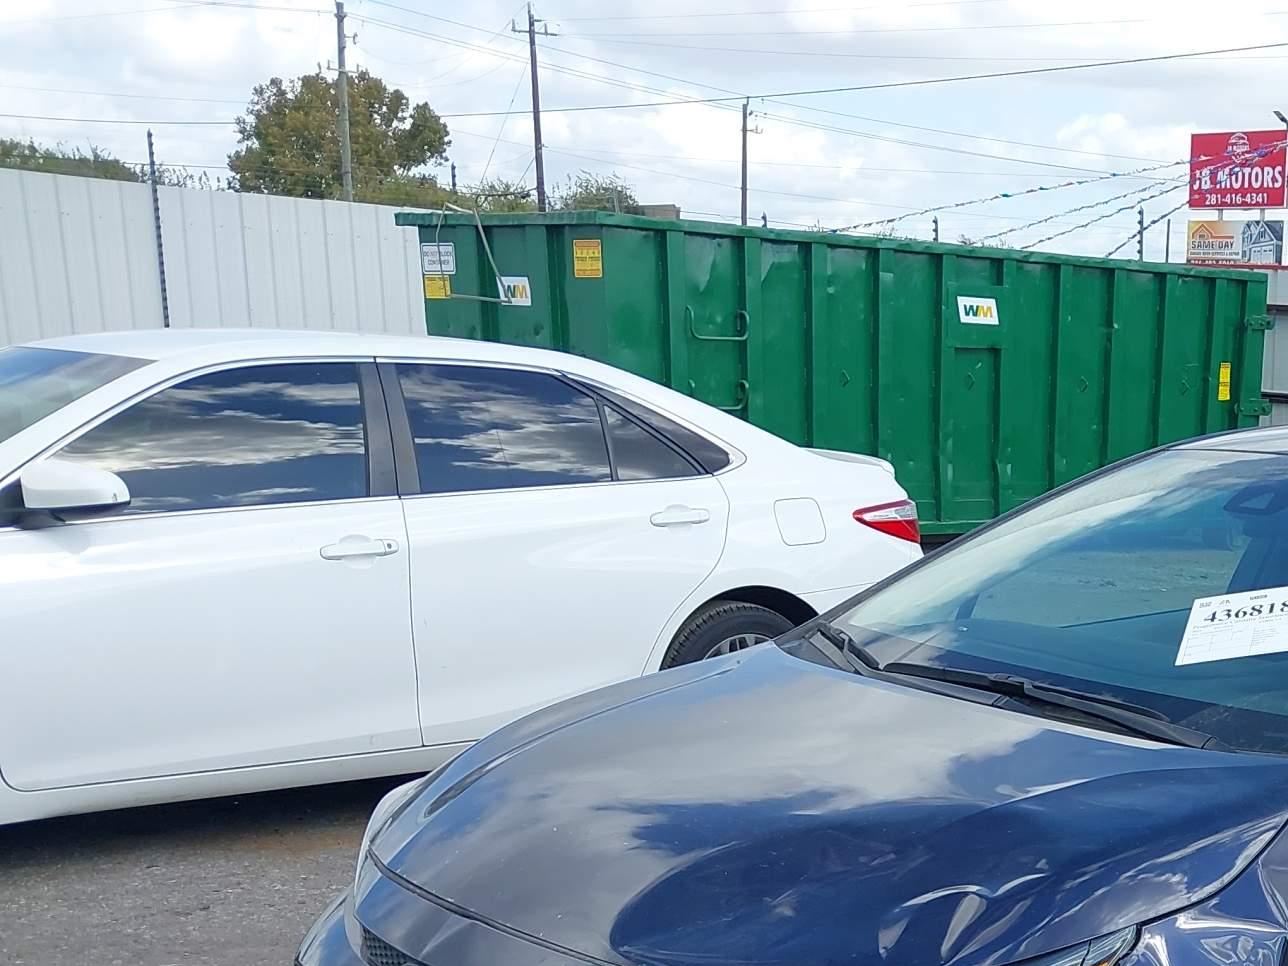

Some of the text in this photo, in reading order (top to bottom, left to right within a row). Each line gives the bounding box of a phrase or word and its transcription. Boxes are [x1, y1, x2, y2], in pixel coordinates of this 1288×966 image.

[1216, 166, 1283, 189] MOTORS
[1205, 193, 1267, 205] 281-416-4341
[1192, 240, 1234, 249] SAME DAY
[963, 304, 993, 318] WM
